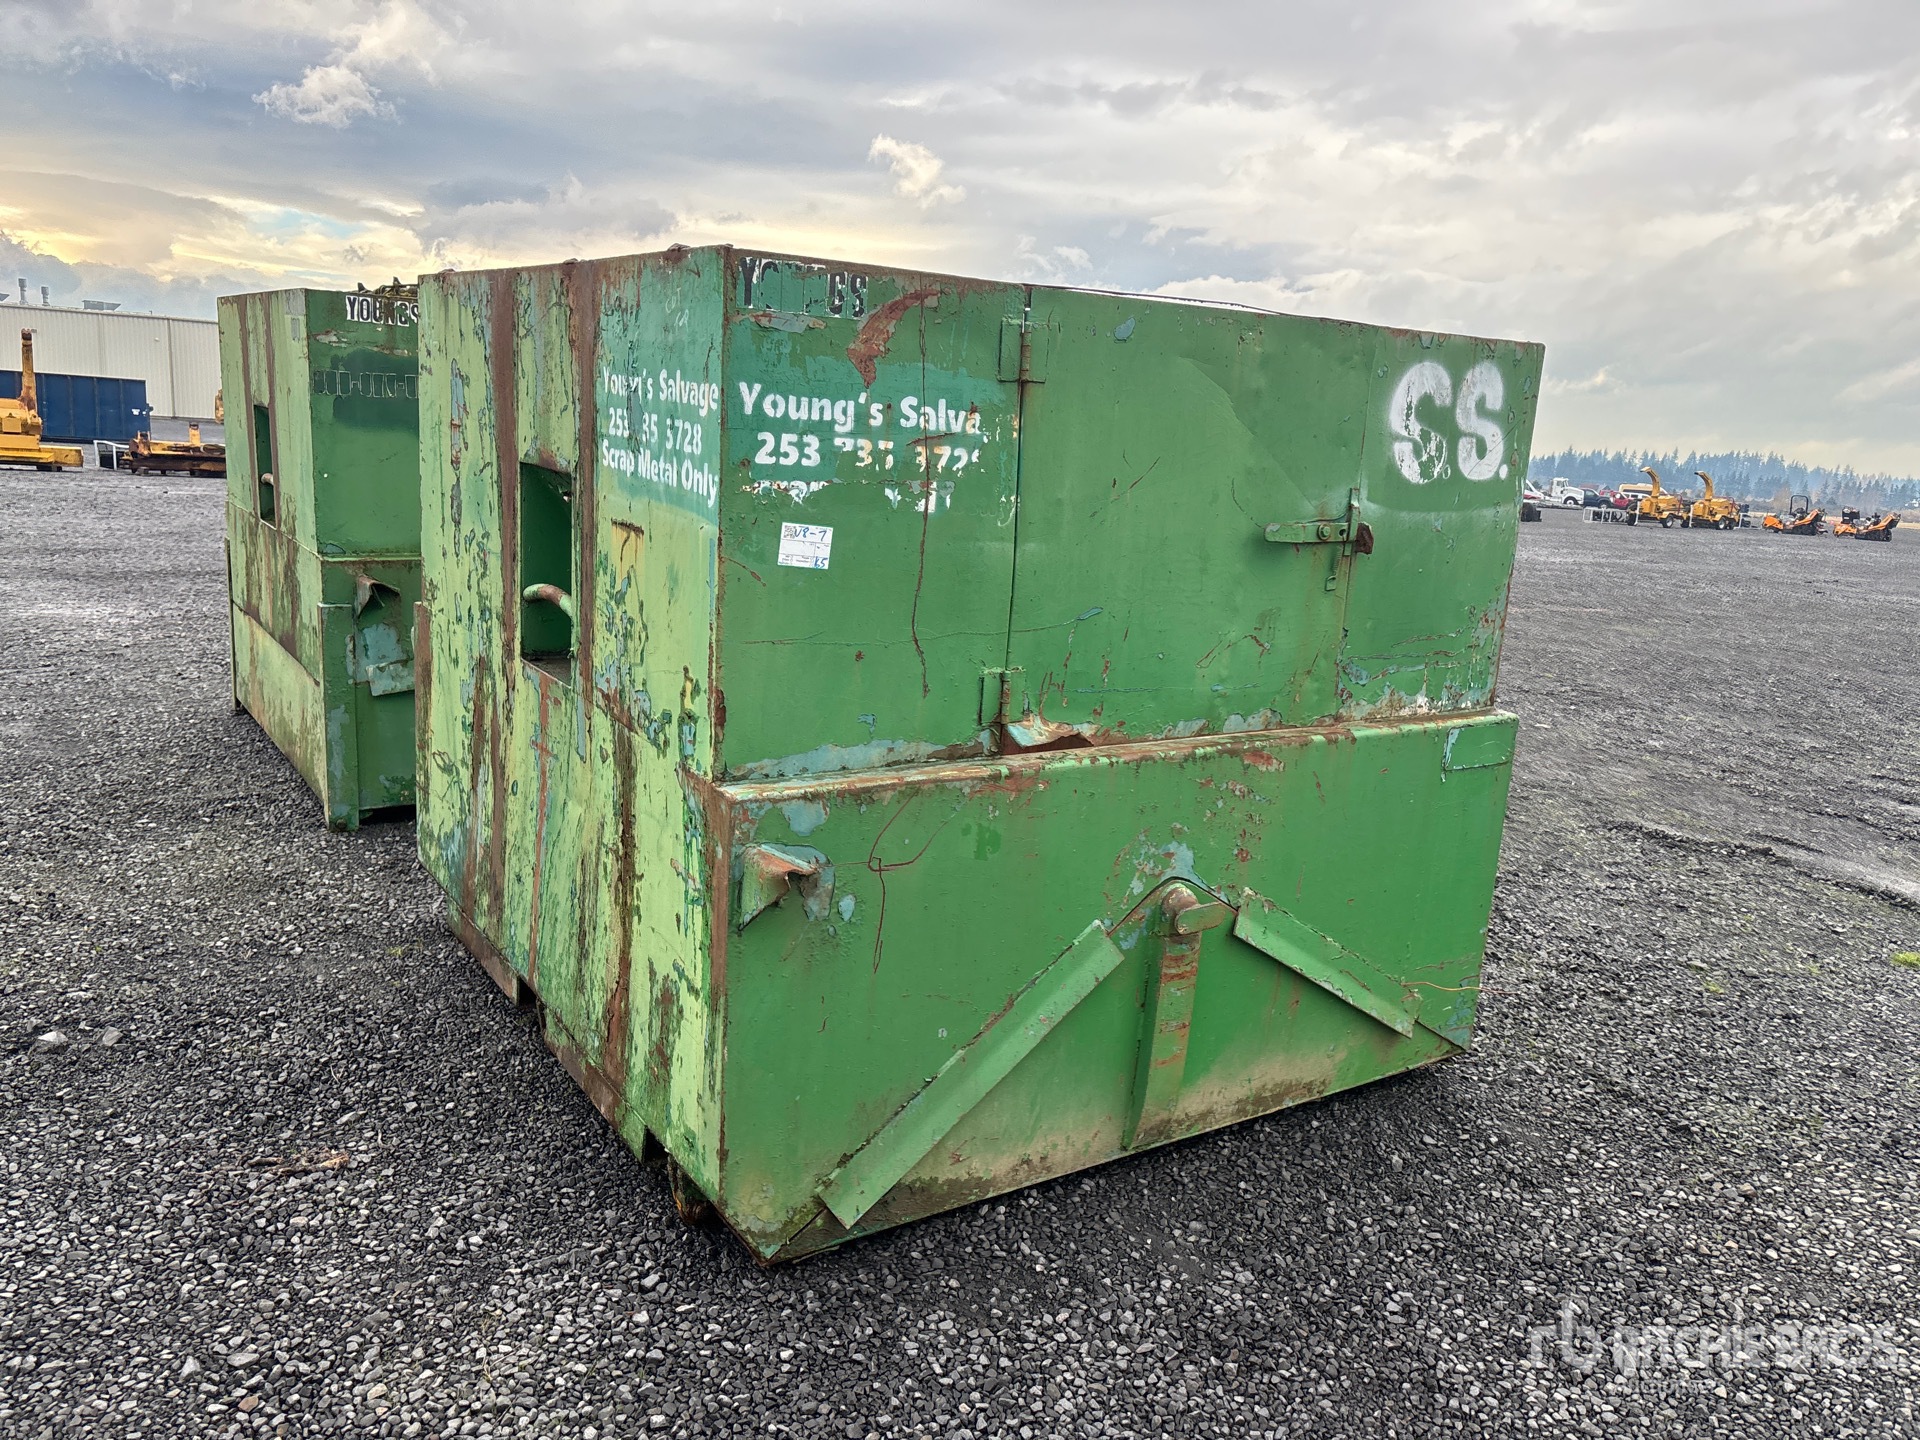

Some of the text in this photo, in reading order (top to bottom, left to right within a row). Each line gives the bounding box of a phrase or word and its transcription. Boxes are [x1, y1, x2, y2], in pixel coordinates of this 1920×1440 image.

[659, 369, 719, 417] Salvage
[739, 381, 884, 432] Young's
[666, 416, 702, 455] 3728
[754, 432, 821, 467] 253
[915, 445, 980, 477] 372
[602, 439, 635, 477] Scrap
[638, 447, 677, 488] Metal
[681, 458, 719, 508] Only
